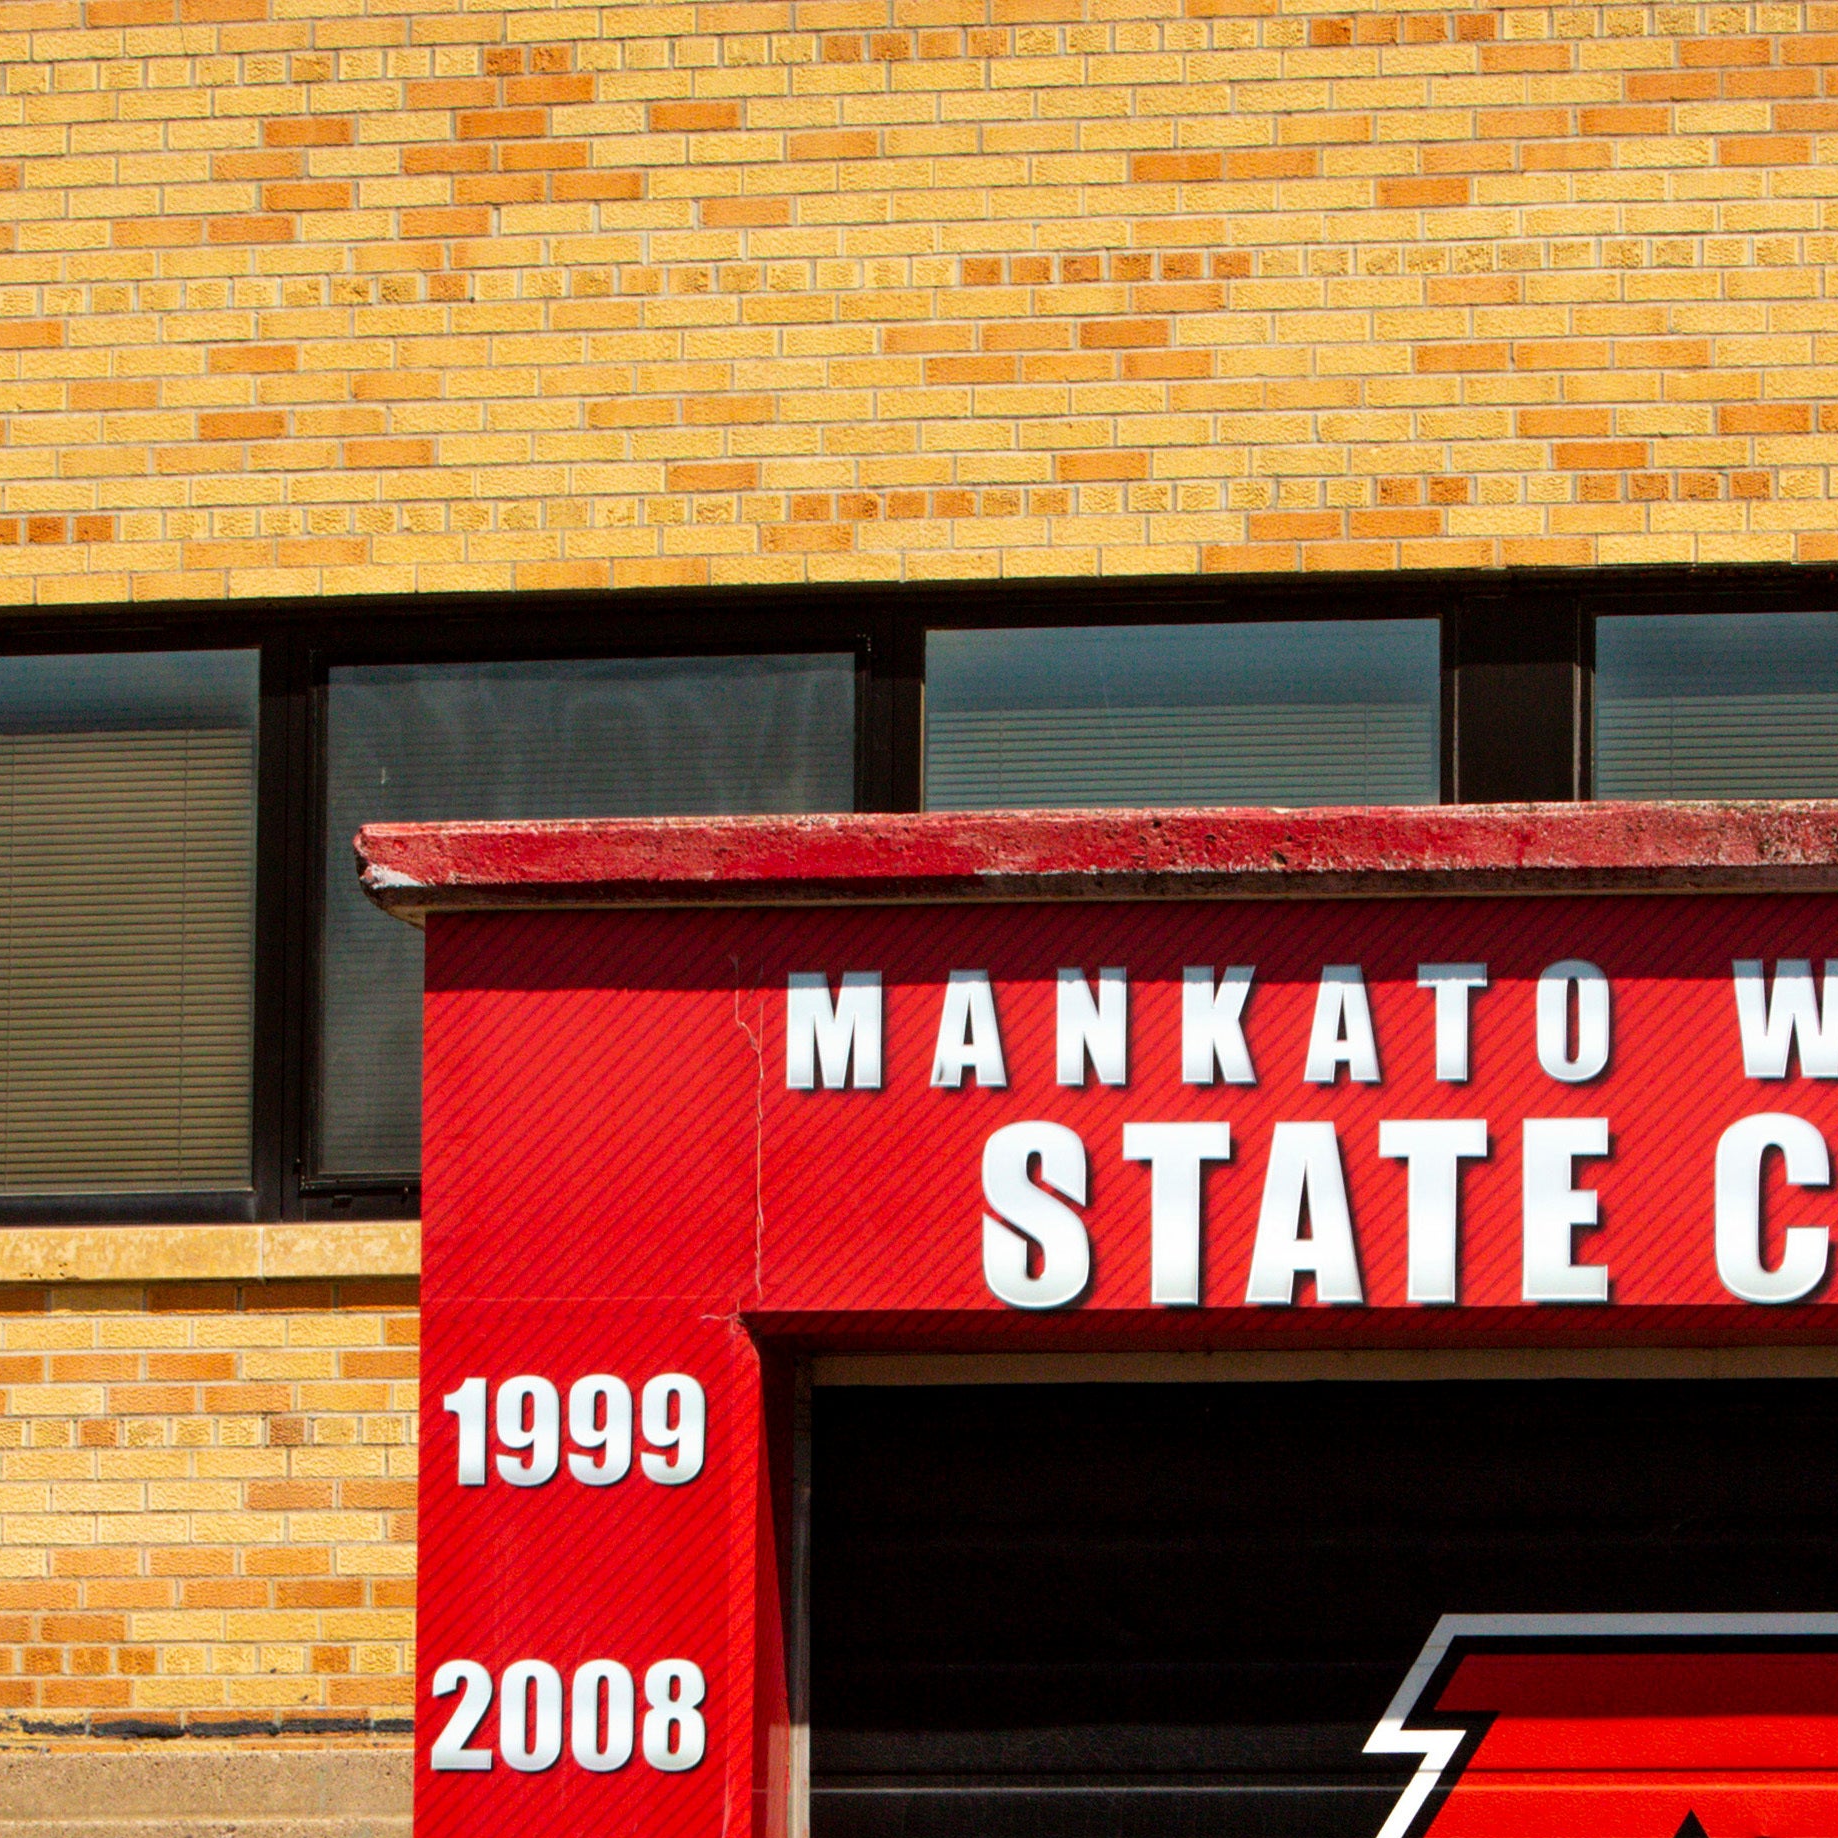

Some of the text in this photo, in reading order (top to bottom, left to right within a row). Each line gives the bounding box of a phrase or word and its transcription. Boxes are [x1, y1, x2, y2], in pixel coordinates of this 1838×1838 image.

[787, 961, 1611, 1090] MANKATO
[982, 1118, 1610, 1309] STATE
[443, 1373, 707, 1487] 1999
[430, 1659, 707, 1773] 2008
